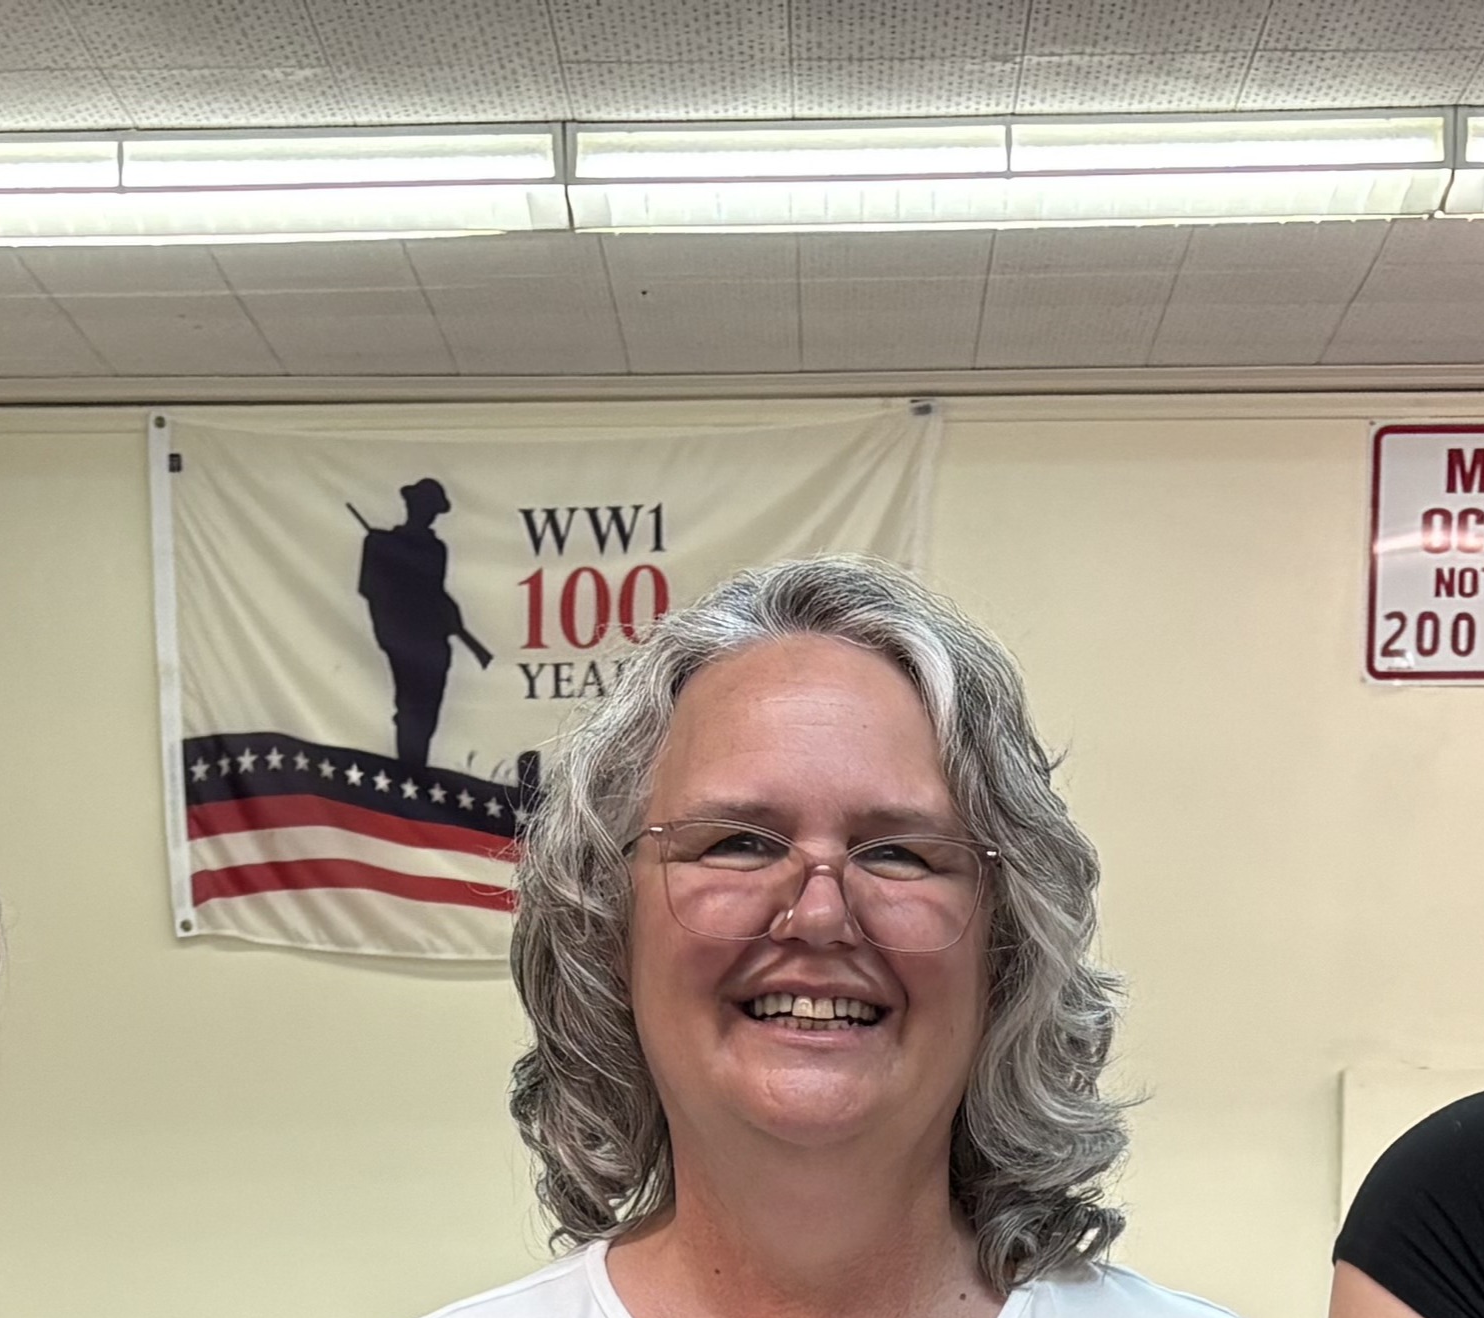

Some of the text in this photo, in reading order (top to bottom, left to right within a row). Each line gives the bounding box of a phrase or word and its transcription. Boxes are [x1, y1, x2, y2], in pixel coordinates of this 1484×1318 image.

[519, 502, 669, 556] WW1
[519, 564, 670, 650] 100
[1379, 610, 1477, 659] 200
[518, 661, 629, 700] YEA
